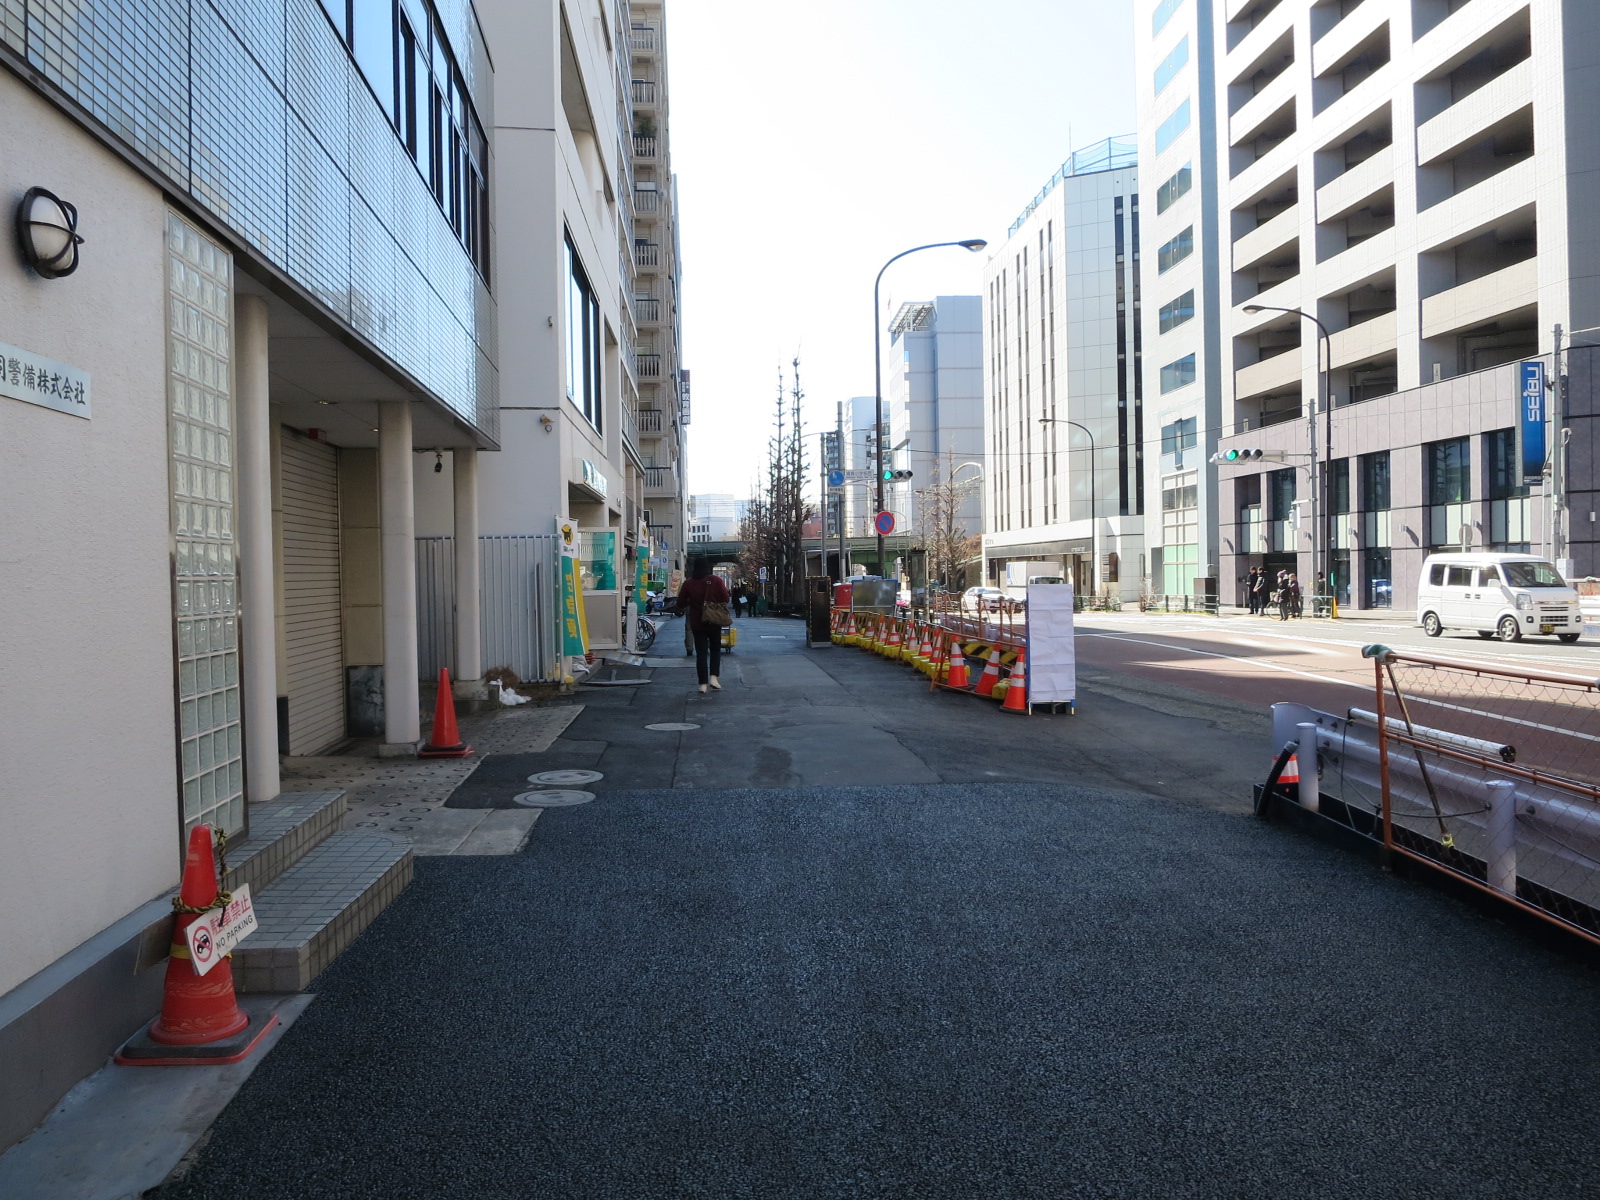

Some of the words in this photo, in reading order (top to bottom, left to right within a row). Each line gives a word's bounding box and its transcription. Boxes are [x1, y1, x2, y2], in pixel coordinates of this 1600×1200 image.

[210, 894, 251, 935] 駐車禁止
[216, 937, 226, 950] NO
[227, 914, 254, 942] PARKING
